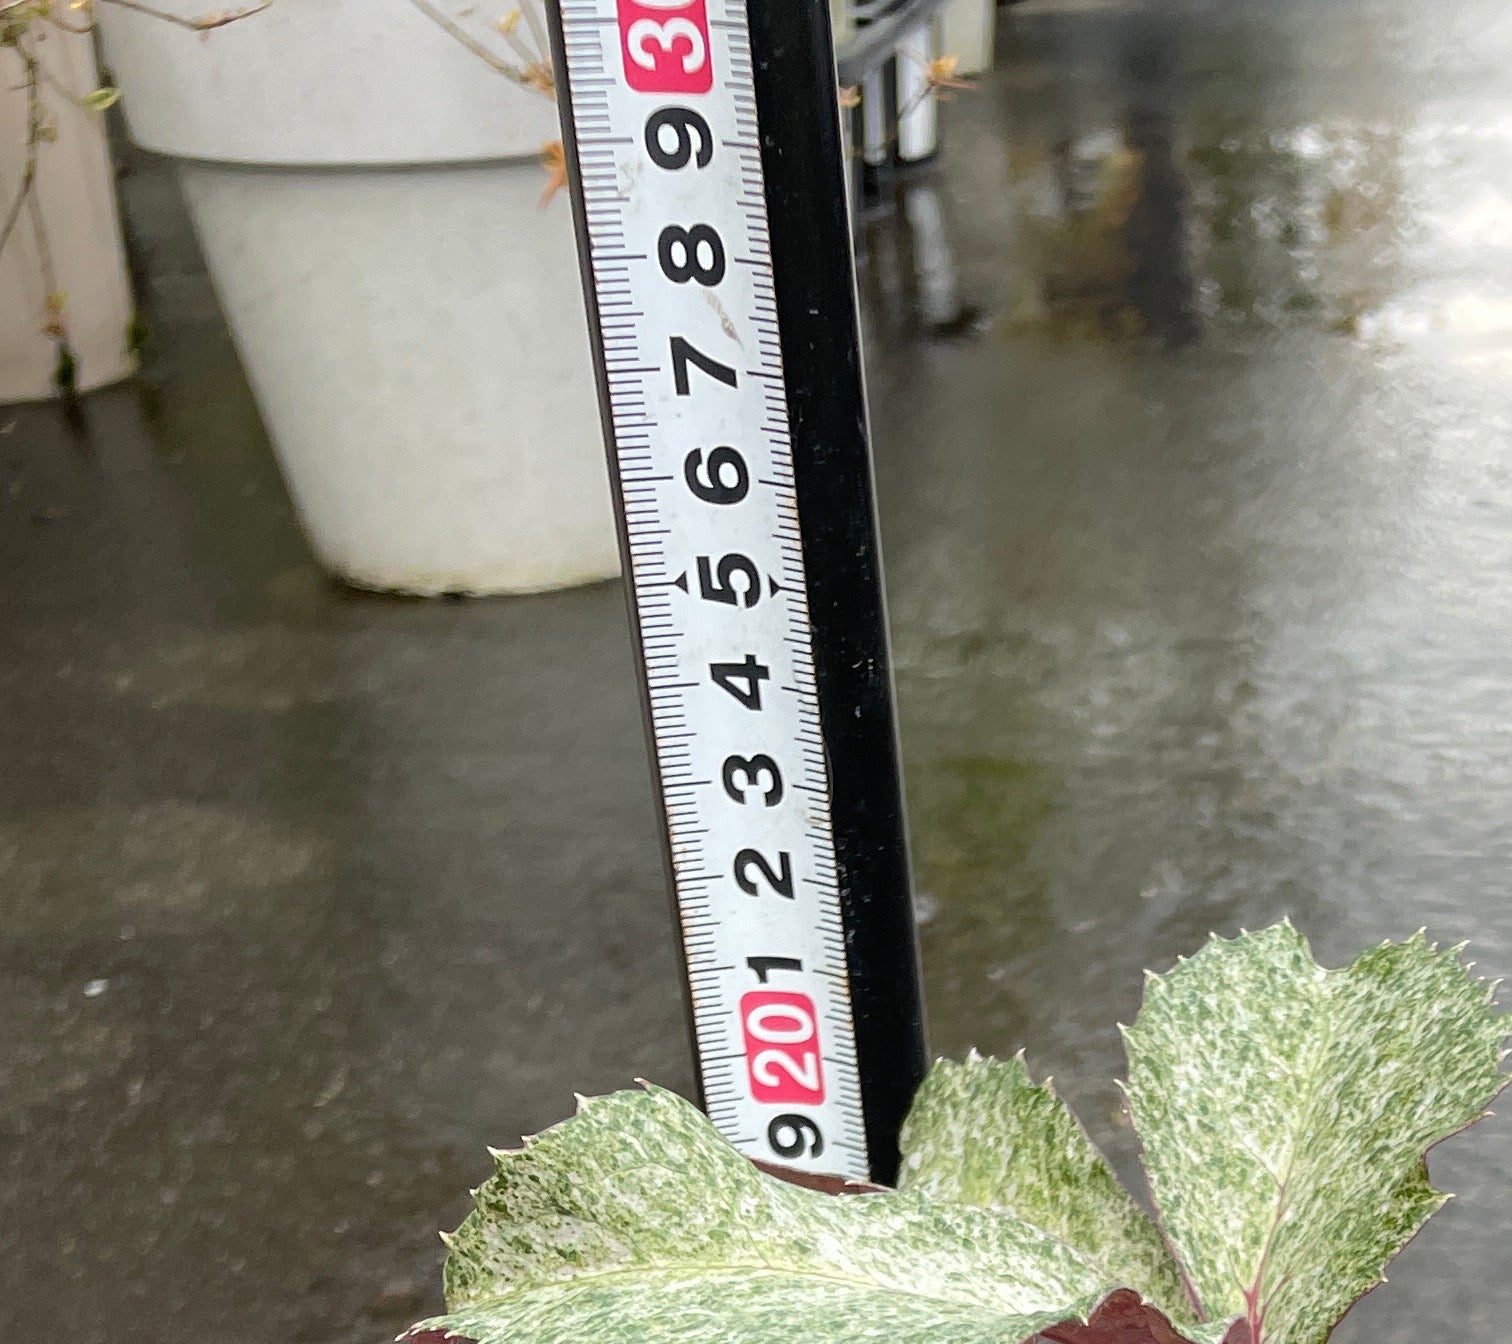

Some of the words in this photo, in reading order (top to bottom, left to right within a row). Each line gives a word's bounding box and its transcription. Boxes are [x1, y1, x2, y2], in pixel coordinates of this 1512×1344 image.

[626, 0, 706, 75] 3
[644, 107, 714, 171] 9
[657, 223, 726, 287] 8
[669, 336, 737, 395] 7
[684, 446, 749, 505] 6
[696, 553, 761, 608] 5
[709, 654, 770, 711] 4
[722, 753, 783, 807] 3
[733, 848, 796, 900] 2
[747, 956, 802, 984] 1
[746, 1003, 820, 1090] 20
[768, 1113, 824, 1159] 9
